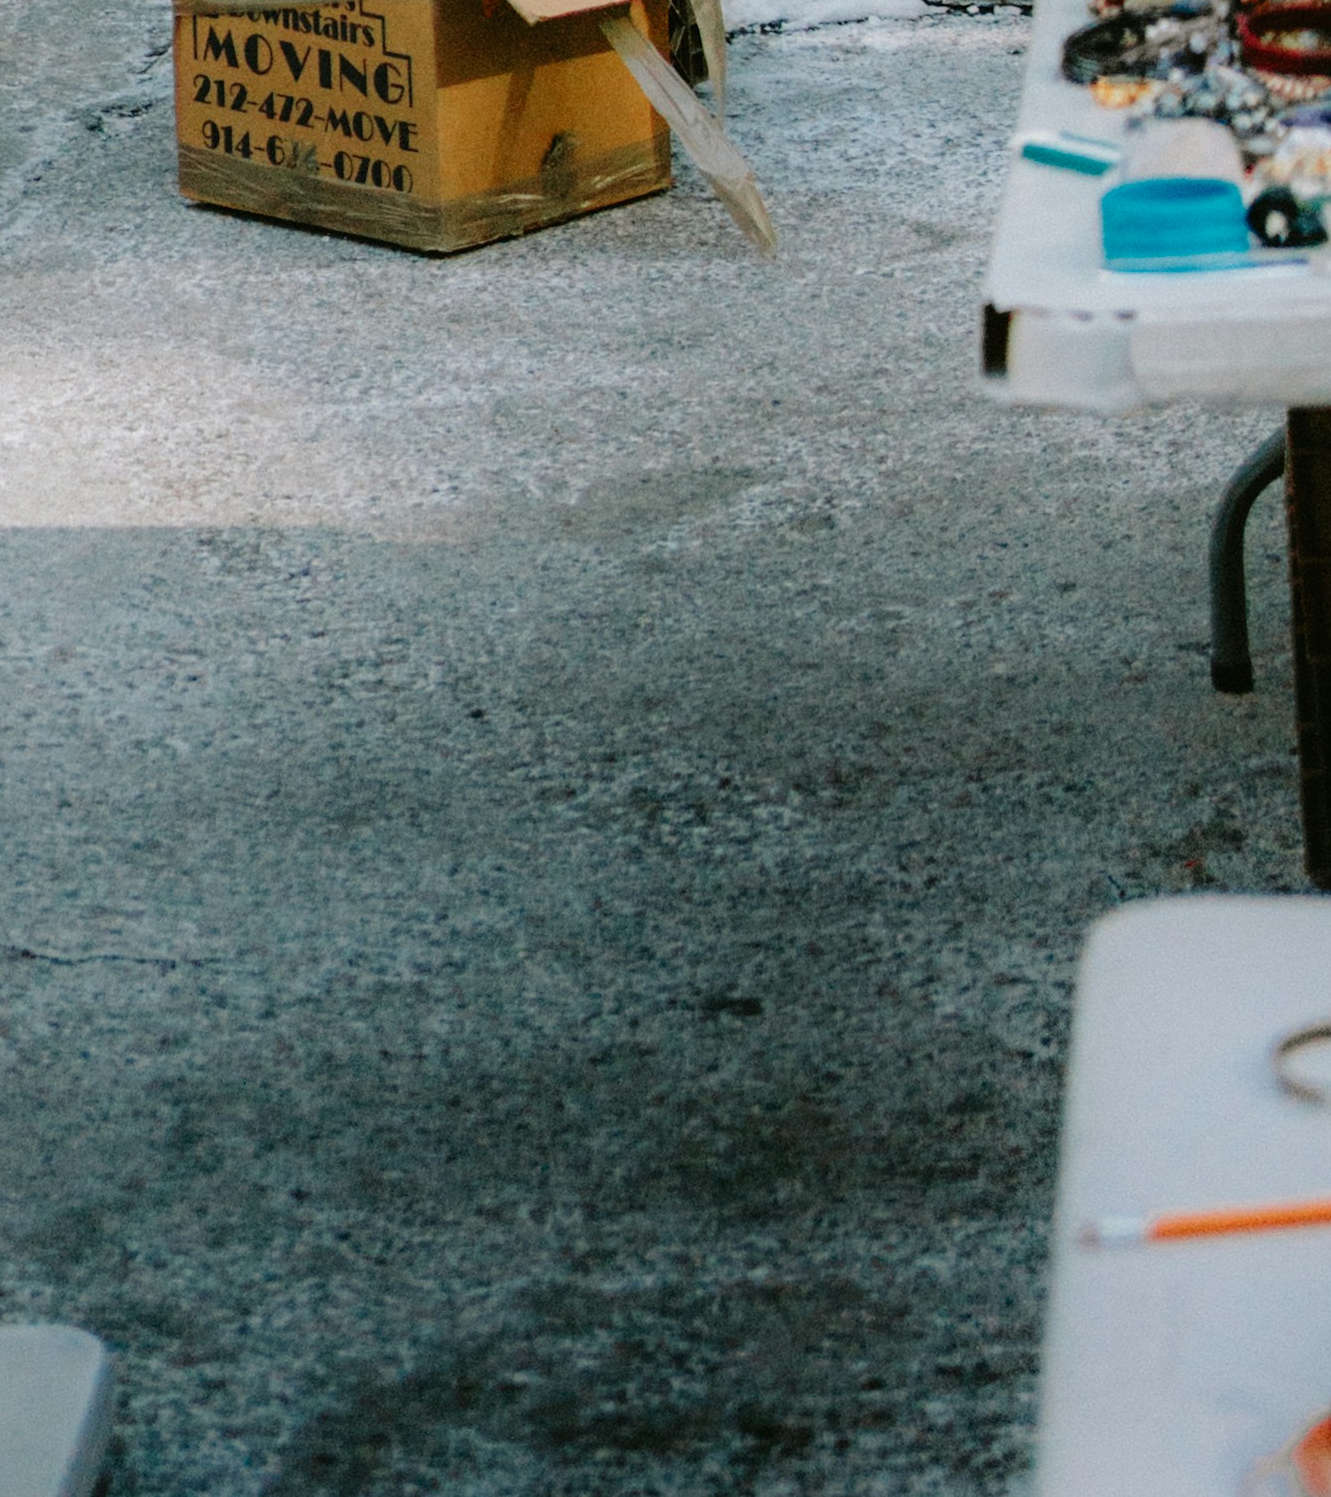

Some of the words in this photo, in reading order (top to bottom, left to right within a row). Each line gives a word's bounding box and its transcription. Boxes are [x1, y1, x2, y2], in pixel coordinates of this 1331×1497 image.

[203, 25, 405, 105] MOVING
[230, 9, 375, 47] ownstairs
[193, 74, 419, 153] 212-472-MOVE
[202, 119, 413, 194] 914-6-0700
